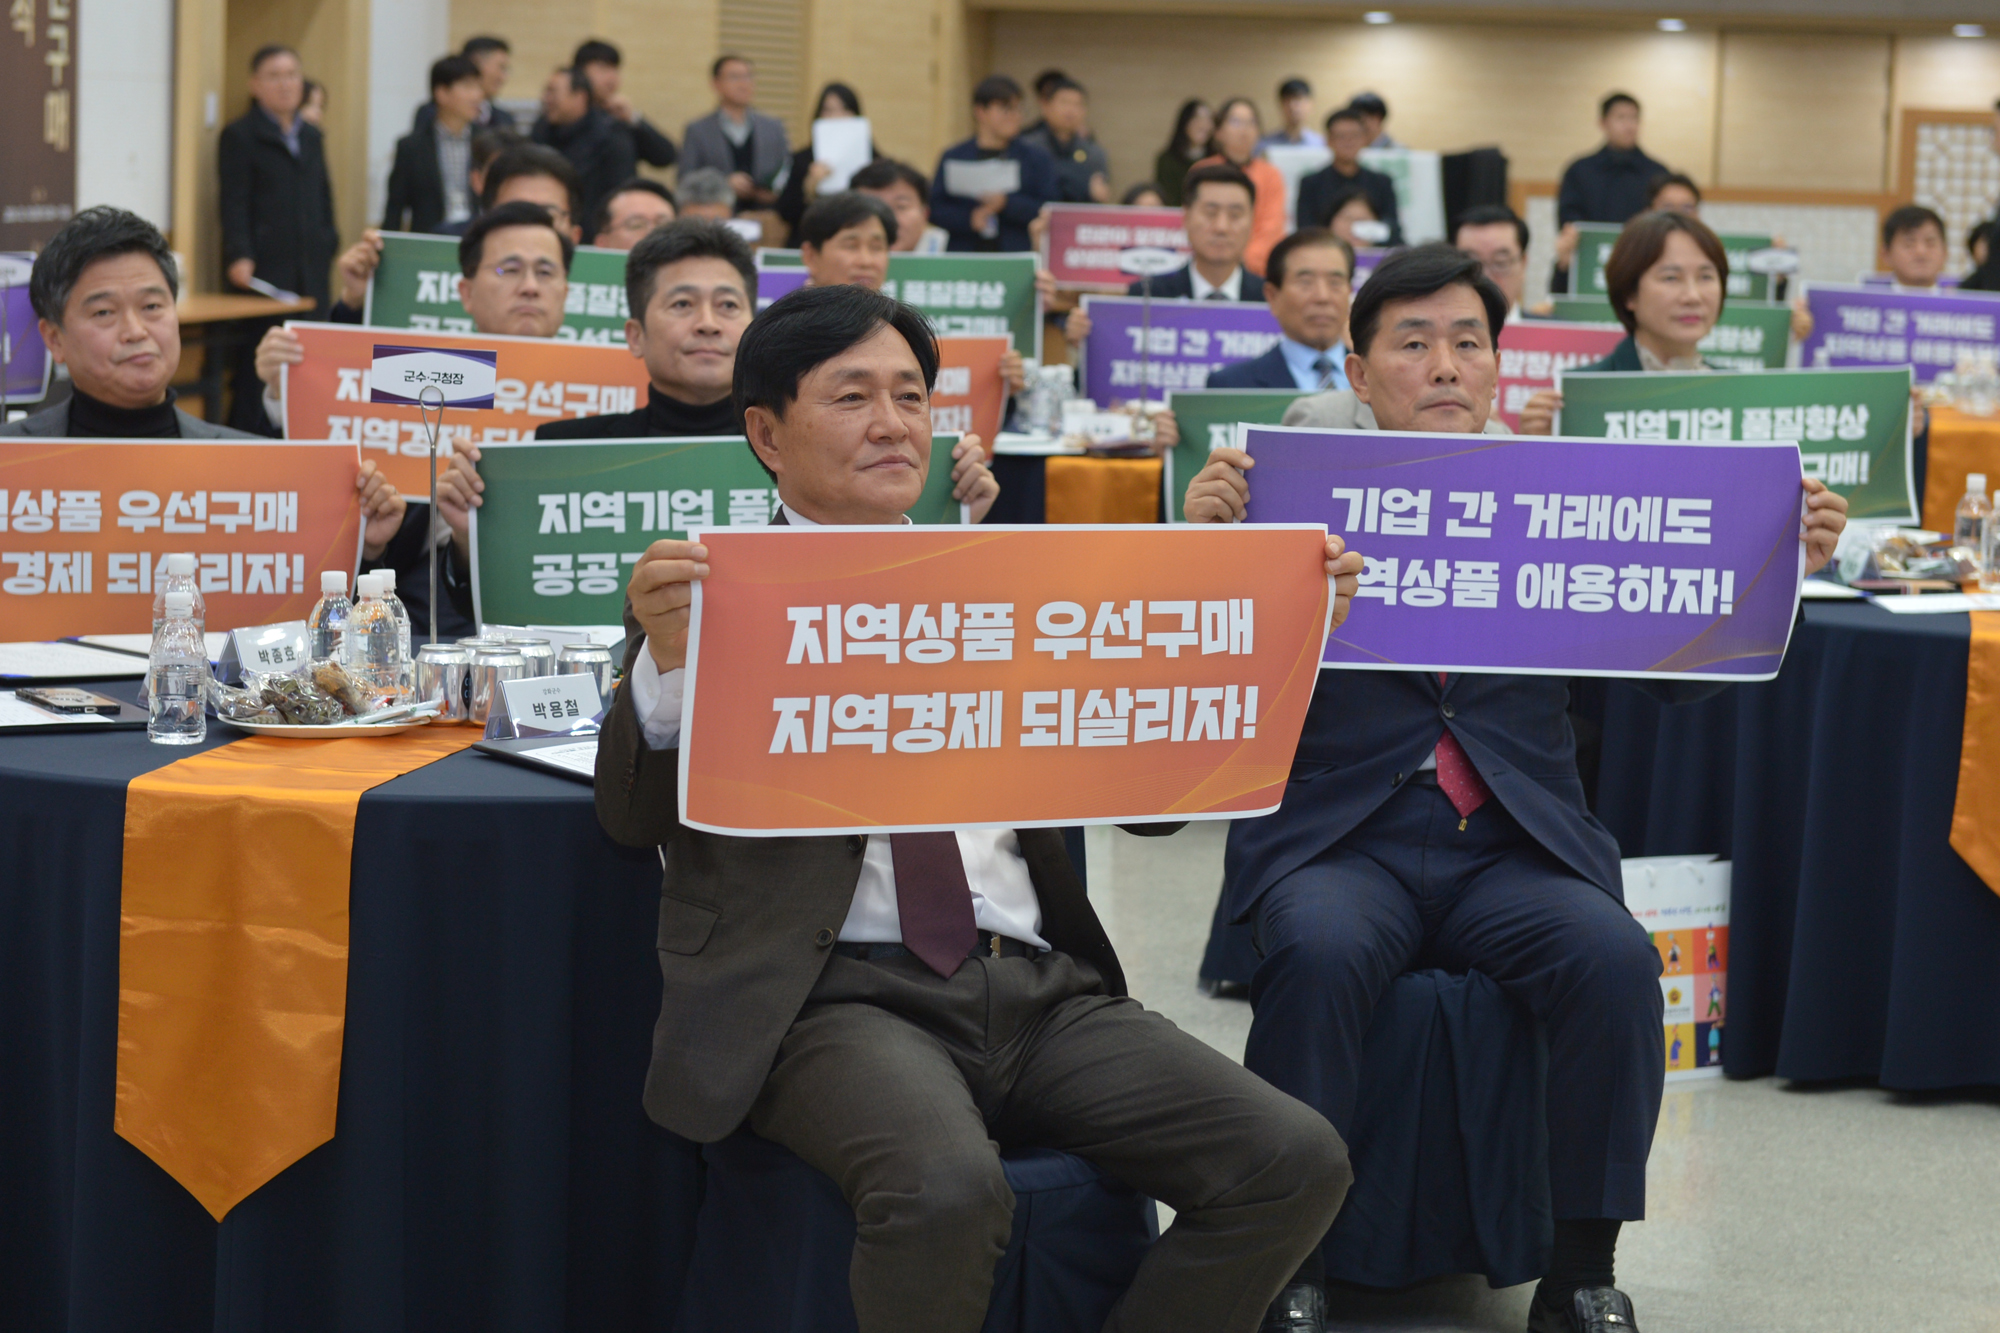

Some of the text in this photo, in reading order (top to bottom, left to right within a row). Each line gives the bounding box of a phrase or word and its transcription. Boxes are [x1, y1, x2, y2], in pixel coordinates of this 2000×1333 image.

[404, 369, 464, 385] 군수·구청장
[494, 377, 637, 419] 우선구매
[1604, 403, 1870, 442] 지역기업 품질향상
[117, 489, 299, 534] 우선구매
[538, 488, 714, 534] 지역기업
[1331, 486, 1713, 545] 기업 간 거래에도
[532, 552, 647, 597] 공공
[1515, 562, 1735, 616] 애용하자!
[786, 598, 1254, 665] 지역상품 우선구매
[258, 645, 297, 666] 박종효
[532, 698, 580, 720] 박용철
[768, 684, 1259, 754] 지역경제 되살리자!
